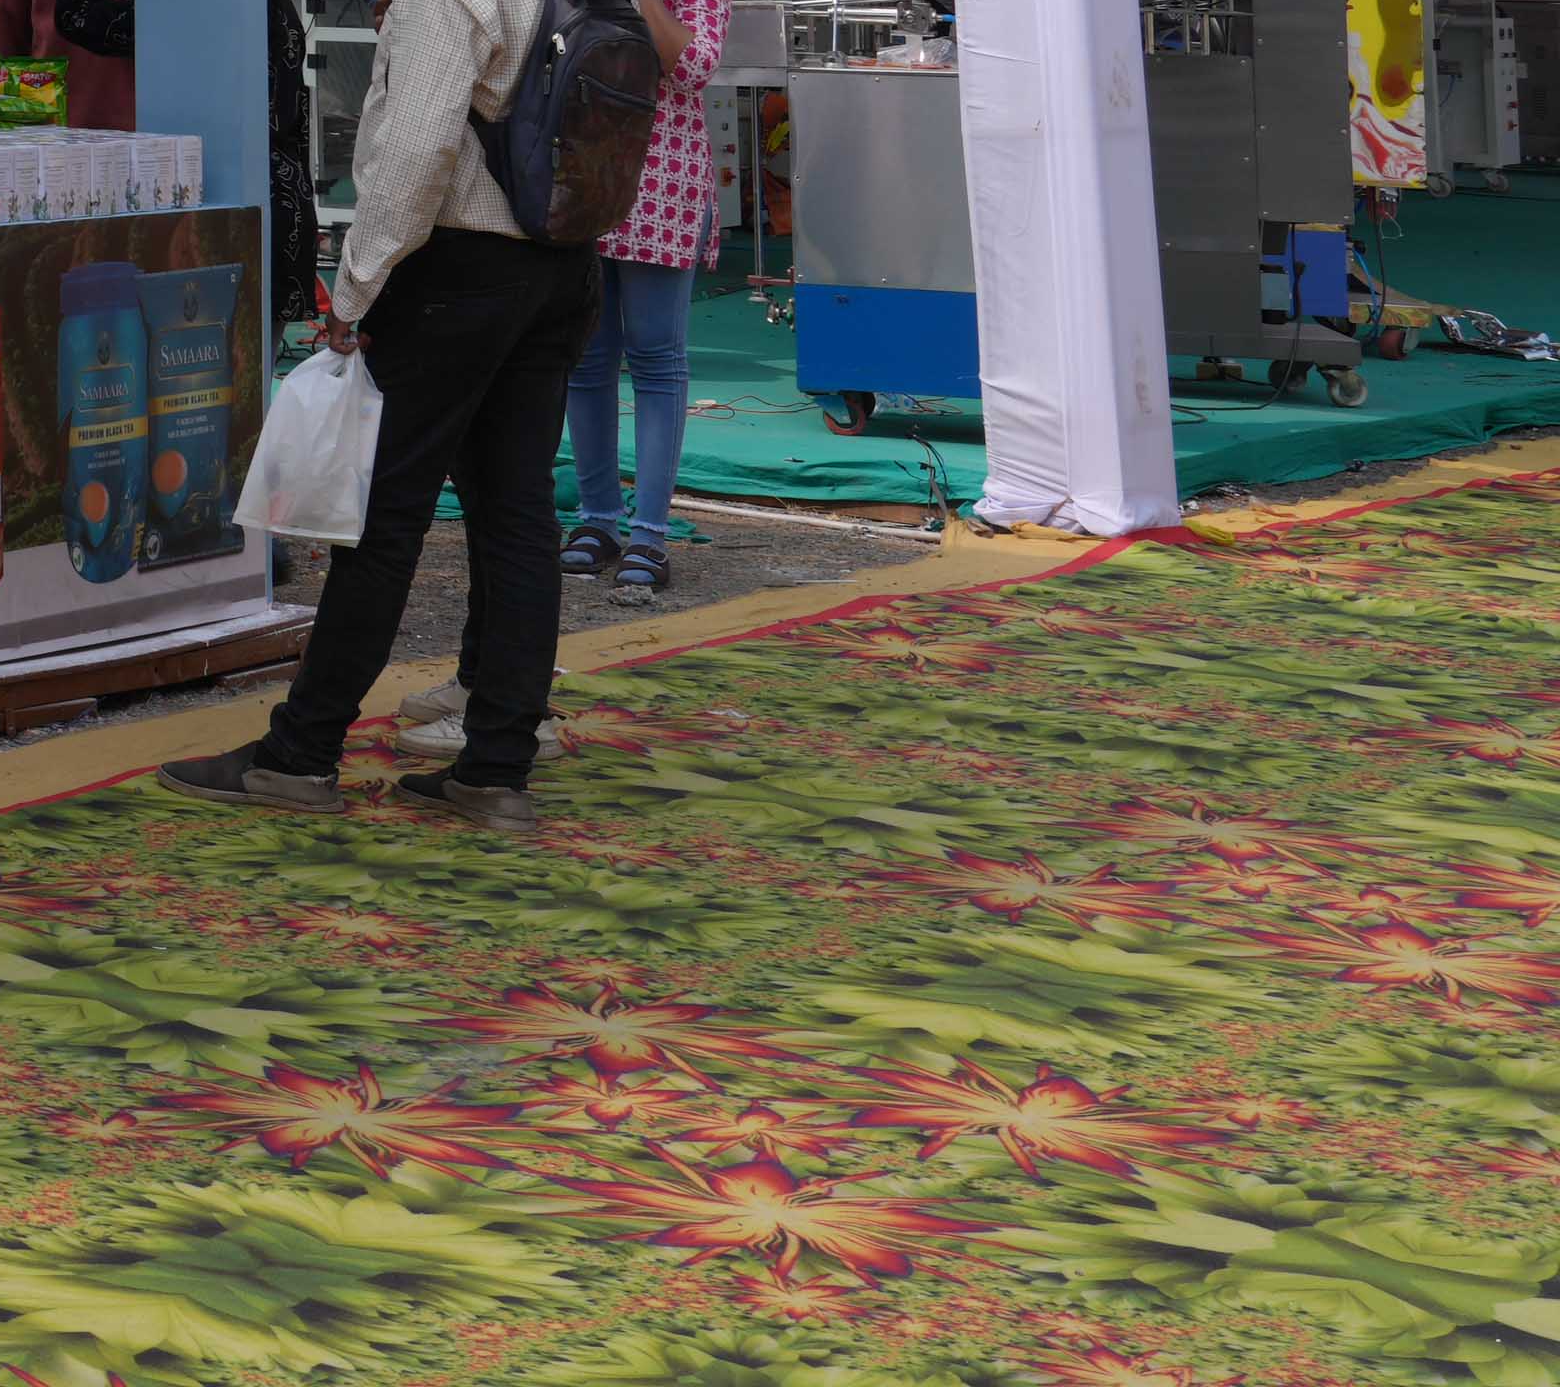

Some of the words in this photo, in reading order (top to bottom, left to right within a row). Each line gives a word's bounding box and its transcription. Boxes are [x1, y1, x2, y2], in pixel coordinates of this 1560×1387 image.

[163, 395, 189, 409] PREMIUM
[191, 392, 208, 404] BLACK
[78, 428, 105, 441] PREMIUM
